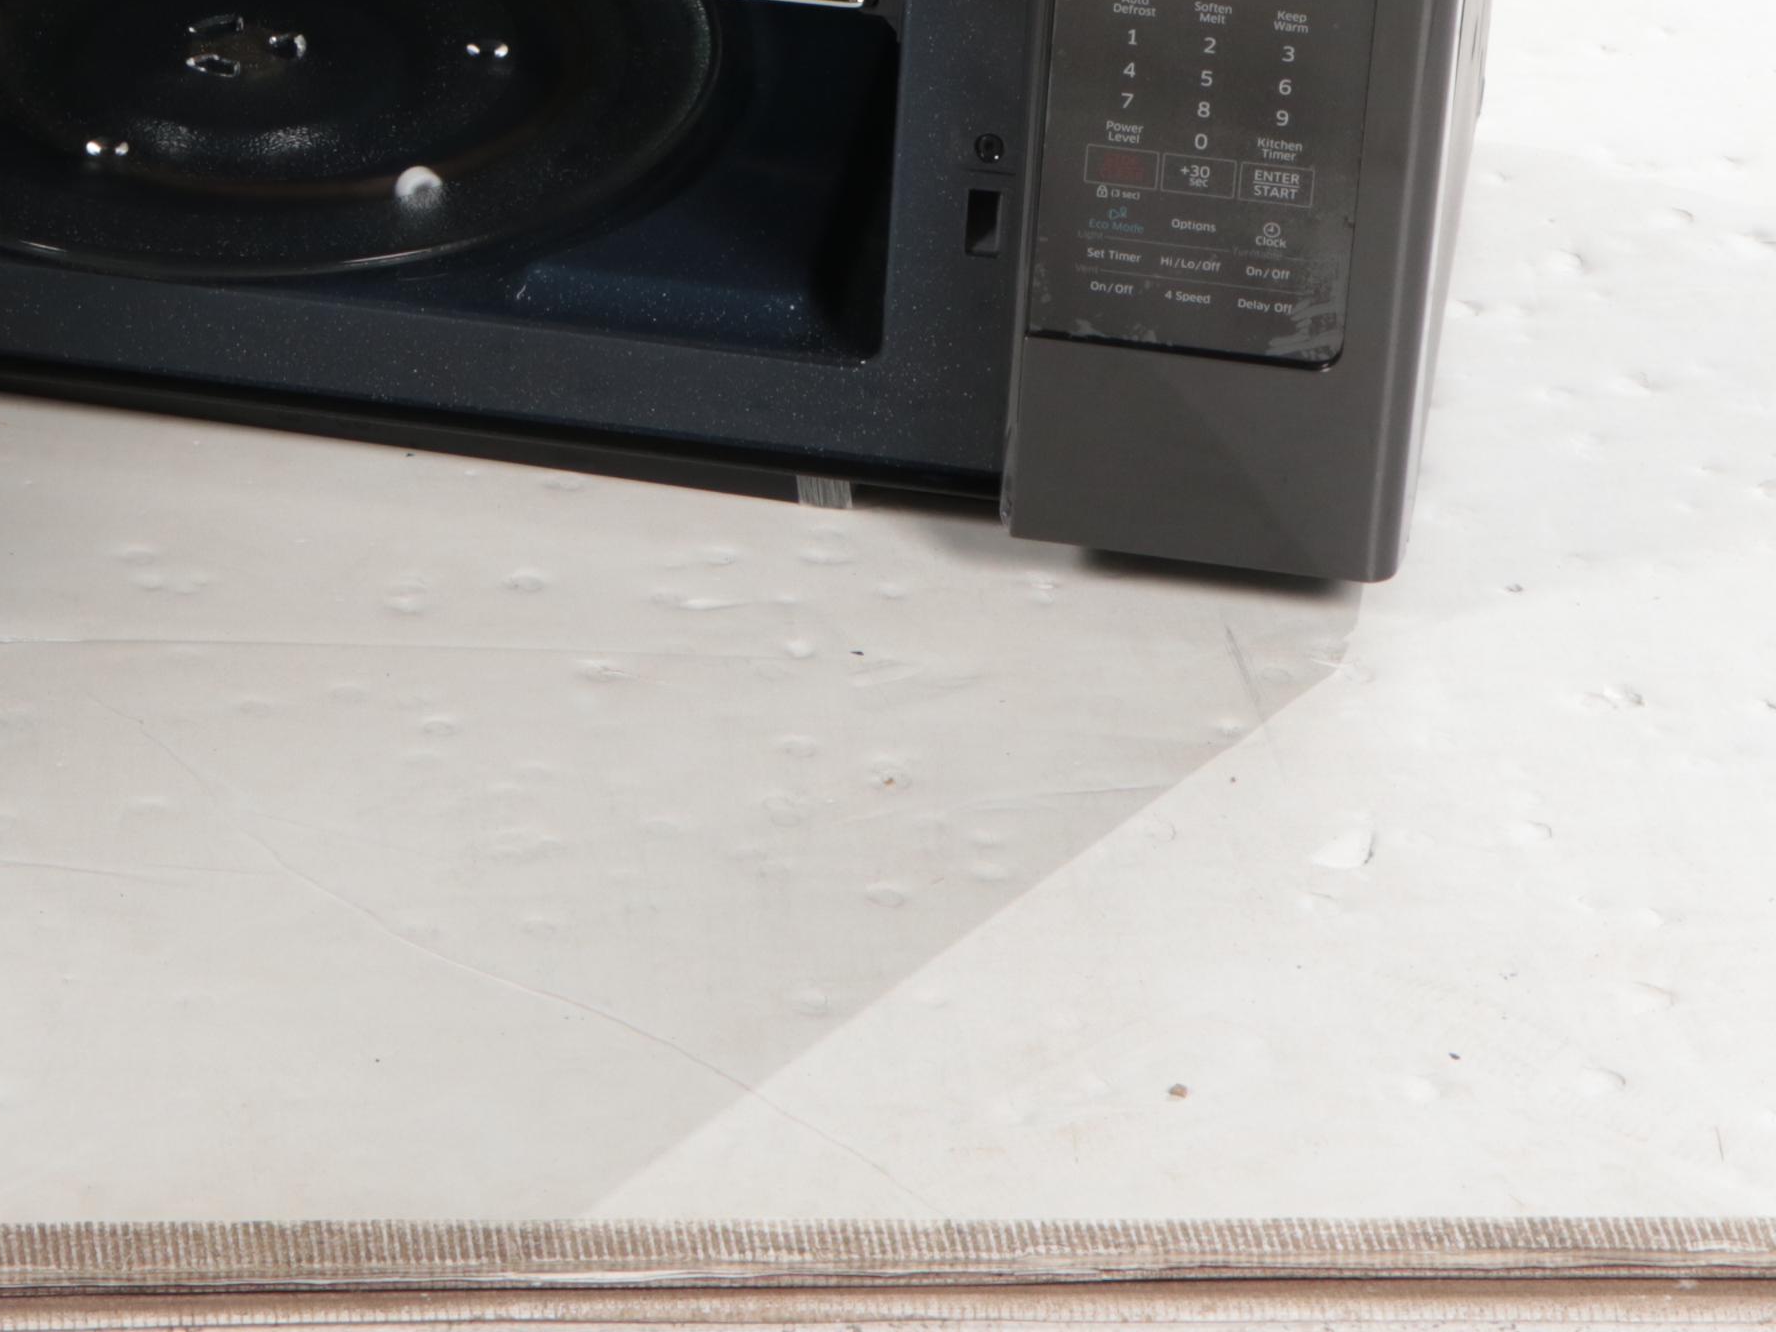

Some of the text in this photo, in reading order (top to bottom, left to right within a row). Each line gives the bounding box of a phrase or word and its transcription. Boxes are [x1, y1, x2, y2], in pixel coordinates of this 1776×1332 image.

[1113, 3, 1156, 17] Defrost
[1194, 1, 1233, 15] Soften
[1200, 13, 1226, 25] Melt
[1277, 10, 1307, 24] Keep
[1274, 21, 1309, 34] Warm
[1128, 30, 1137, 45] 1
[1204, 38, 1216, 54] 2
[1283, 46, 1295, 62] 3
[1123, 63, 1136, 78] 4
[1201, 71, 1213, 86] 5
[1279, 80, 1292, 95] 6
[1121, 92, 1134, 108] 7
[1197, 102, 1210, 117] 8
[1276, 111, 1288, 126] 9
[1106, 120, 1144, 134] Power
[1108, 131, 1140, 144] Level
[1195, 133, 1208, 150] 0
[1257, 138, 1303, 152] Kitchen
[1262, 149, 1296, 162] Timer
[1180, 165, 1210, 179] +30
[1254, 170, 1300, 185] ENTER
[1189, 176, 1208, 188] sec
[1254, 185, 1298, 200] START
[1088, 218, 1144, 234] Eco Mode
[1171, 218, 1216, 233] Options
[1255, 235, 1286, 249] Clock
[1087, 247, 1141, 263] Set Timer
[1165, 290, 1211, 306] 4 Speed
[1237, 299, 1293, 315] Delay Off
